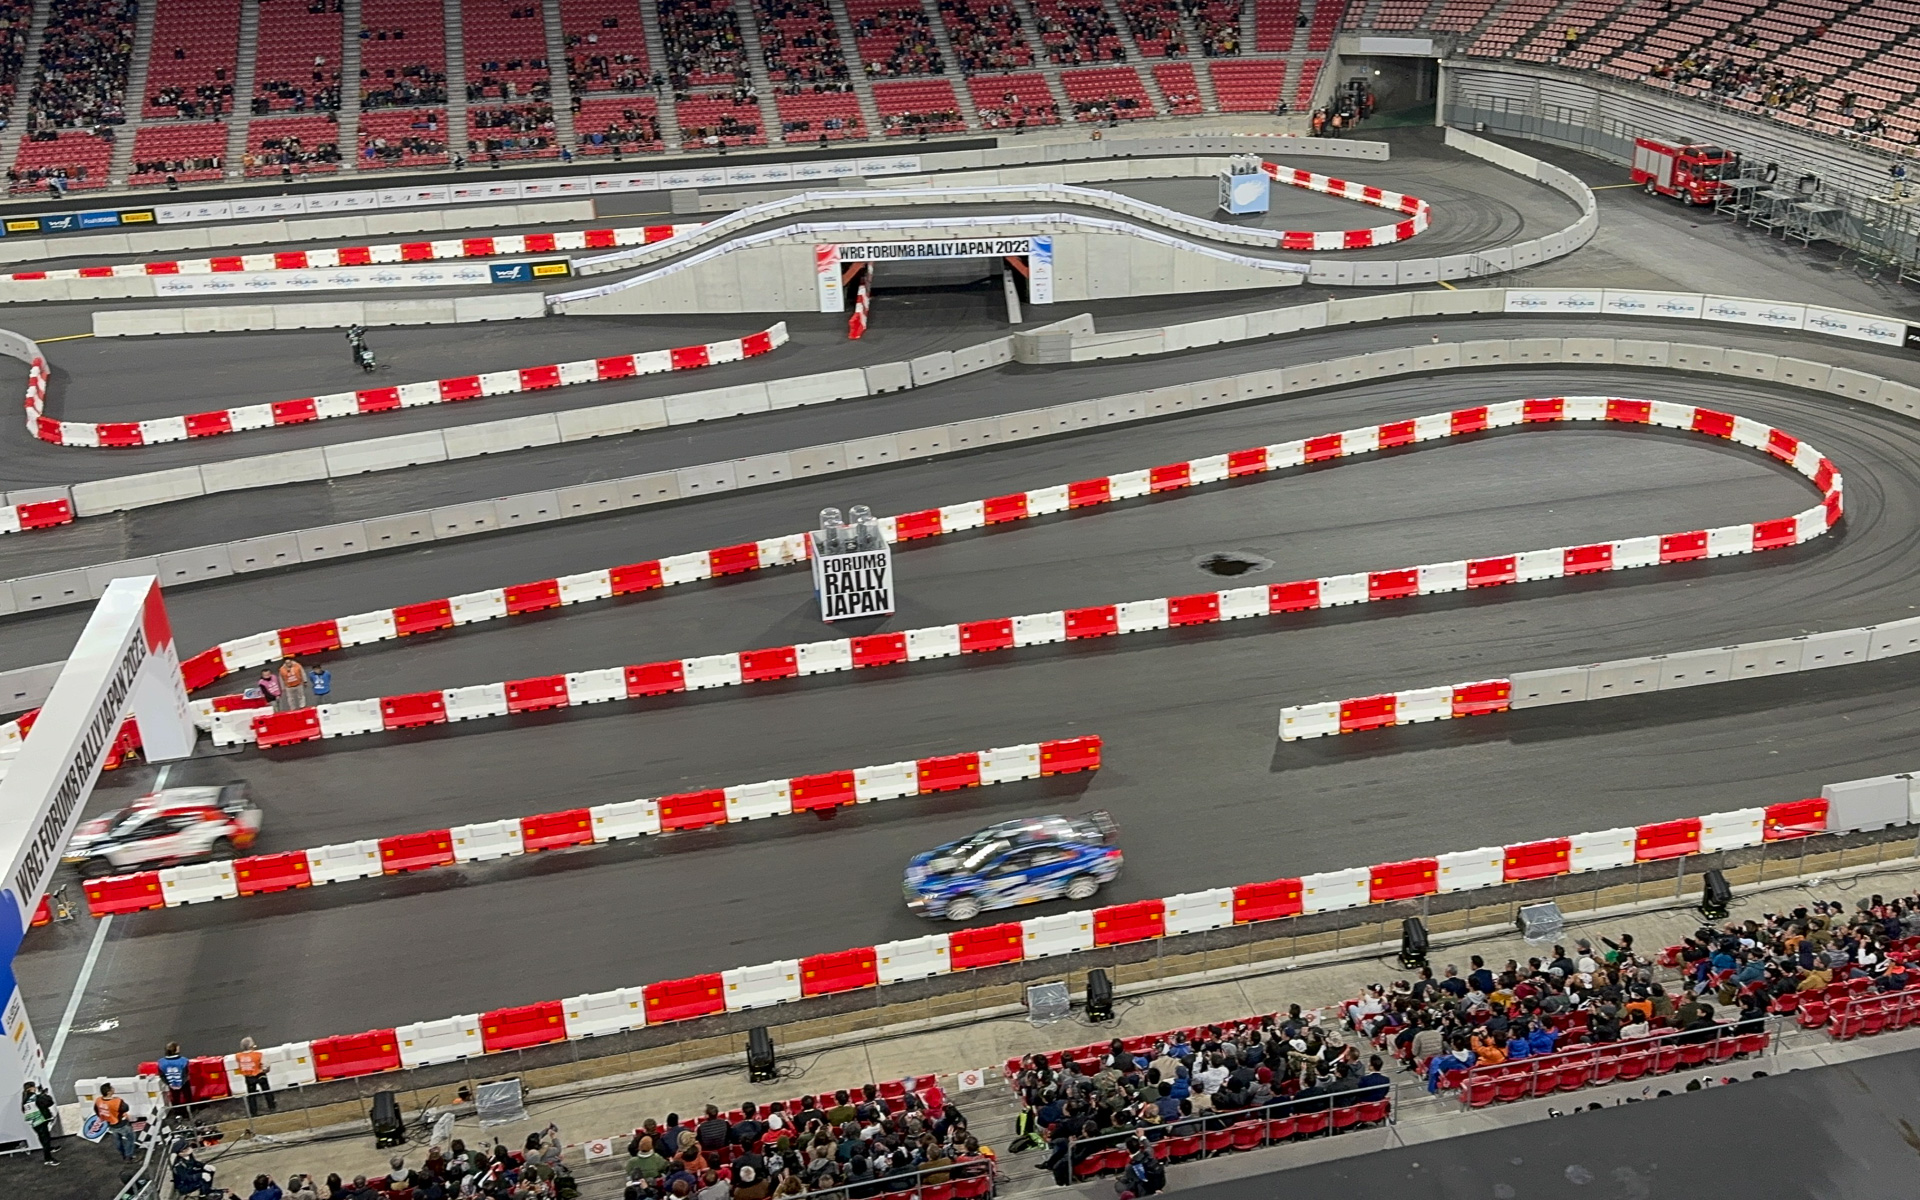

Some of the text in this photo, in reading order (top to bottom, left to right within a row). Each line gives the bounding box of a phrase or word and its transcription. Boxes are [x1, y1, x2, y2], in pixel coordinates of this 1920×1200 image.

[839, 240, 1029, 259] WRC FORUM8 RALLY JAPAN 2023
[823, 553, 887, 573] FORUM8
[824, 568, 886, 595] RALLY
[826, 589, 889, 617] JAPAN
[15, 626, 147, 907] WRC FORUM8 RALLY JAPAN 2023
